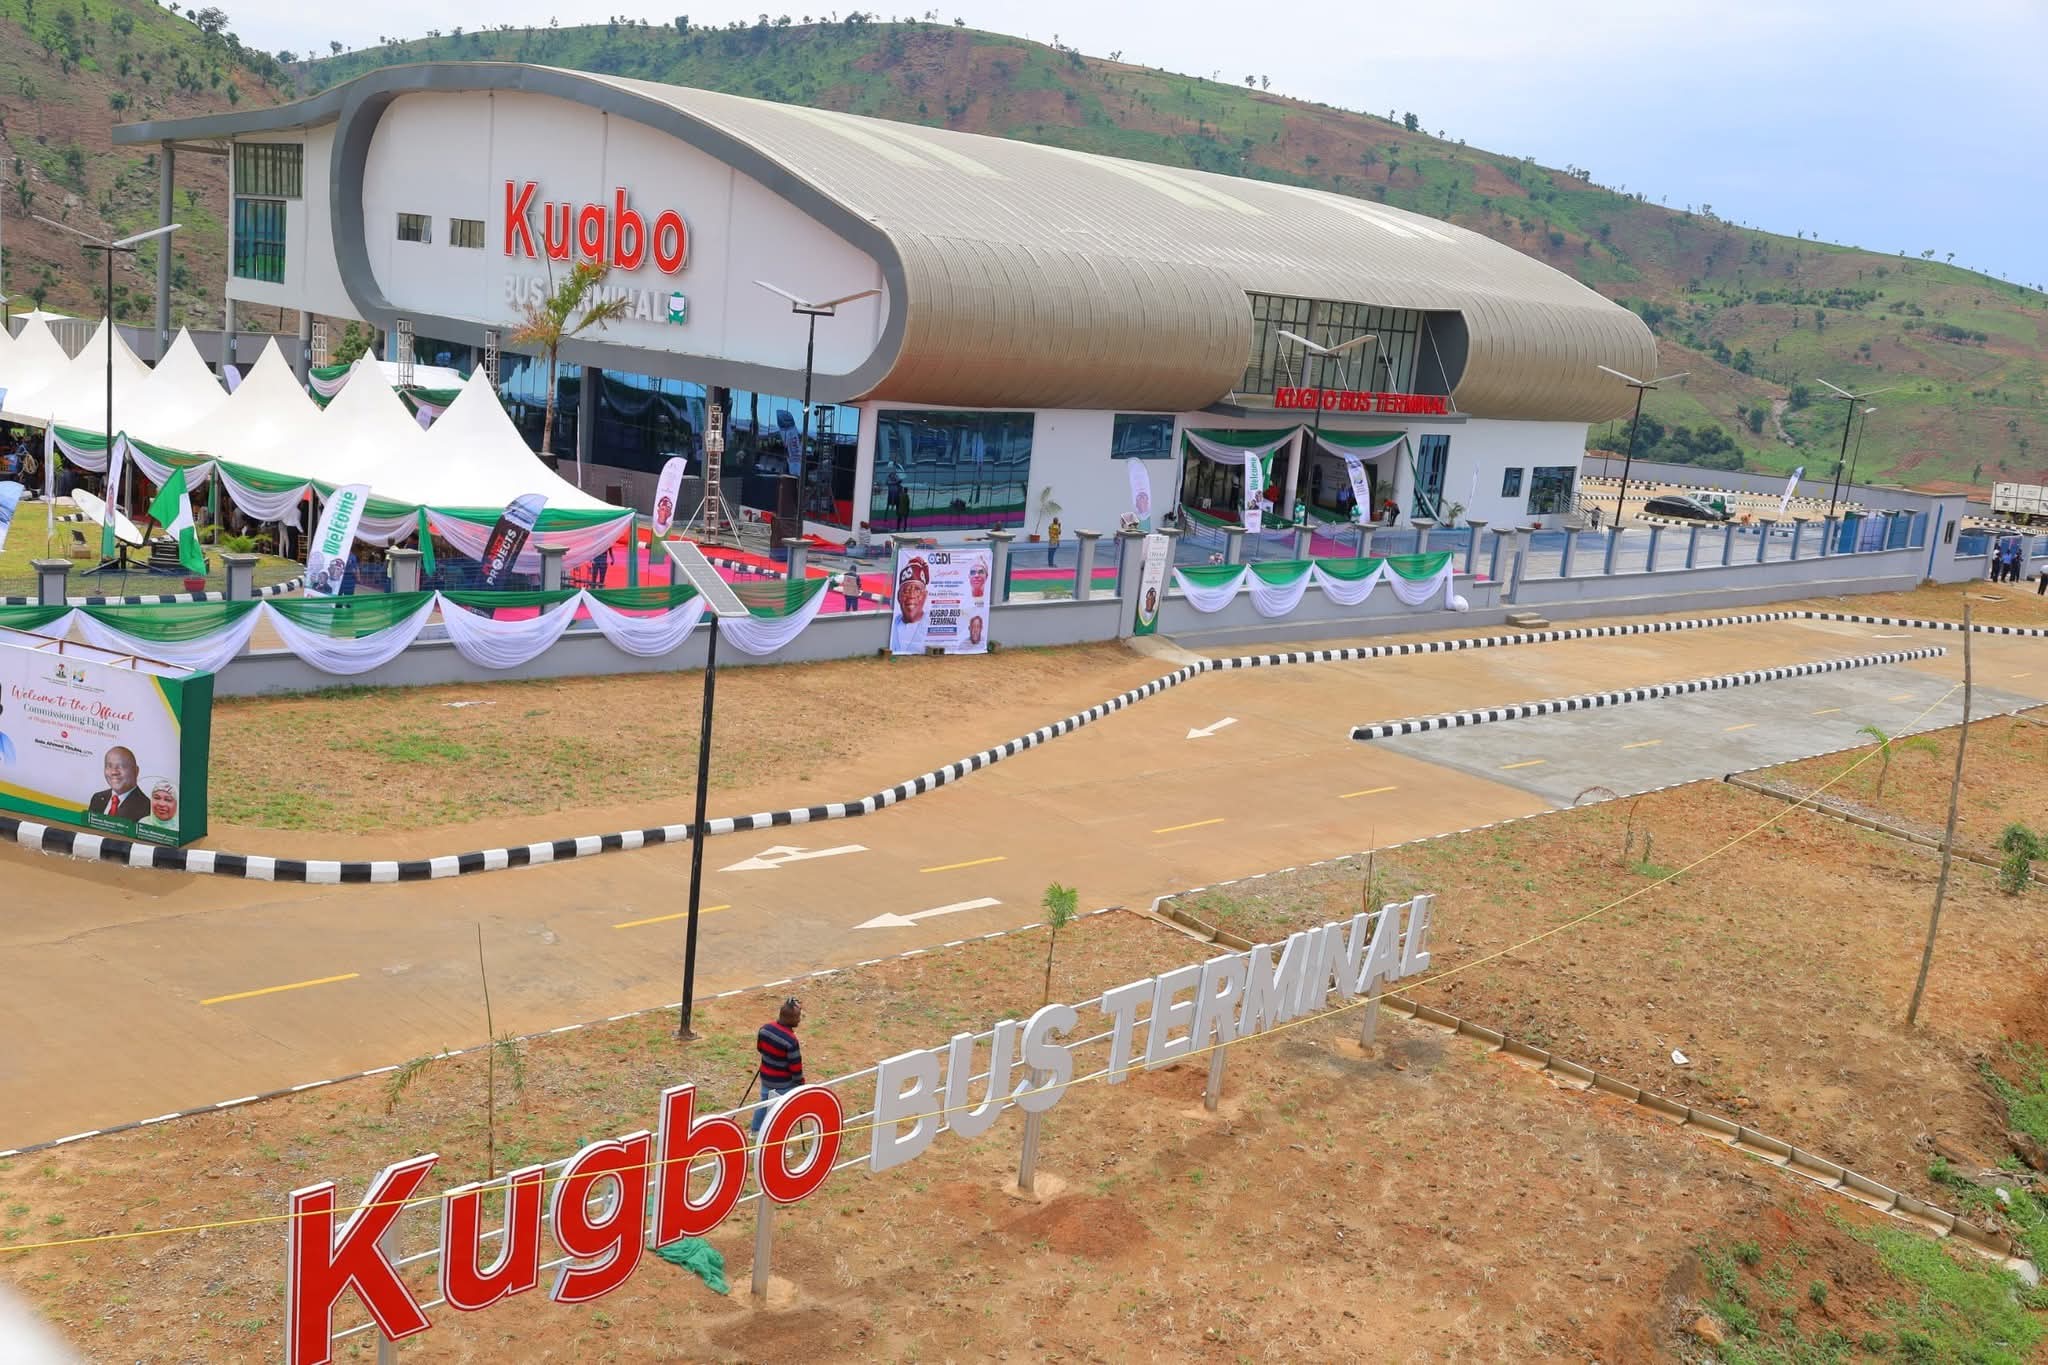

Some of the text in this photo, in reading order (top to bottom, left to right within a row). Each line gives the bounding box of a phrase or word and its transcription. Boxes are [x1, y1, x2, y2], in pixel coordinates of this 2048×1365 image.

[504, 180, 689, 275] Kugbo
[504, 274, 546, 309] BUS
[1338, 391, 1372, 412] BUS
[1375, 392, 1449, 415] TERMINAL
[1249, 456, 1258, 491] Welcome
[322, 491, 357, 556] Welcome
[486, 528, 517, 586] PROJECTS
[11, 684, 54, 704] Welcome
[55, 695, 67, 707] to
[70, 698, 88, 712] the
[90, 700, 135, 722] Official
[286, 894, 1433, 1365] Kugbo BUS TERMINAL
